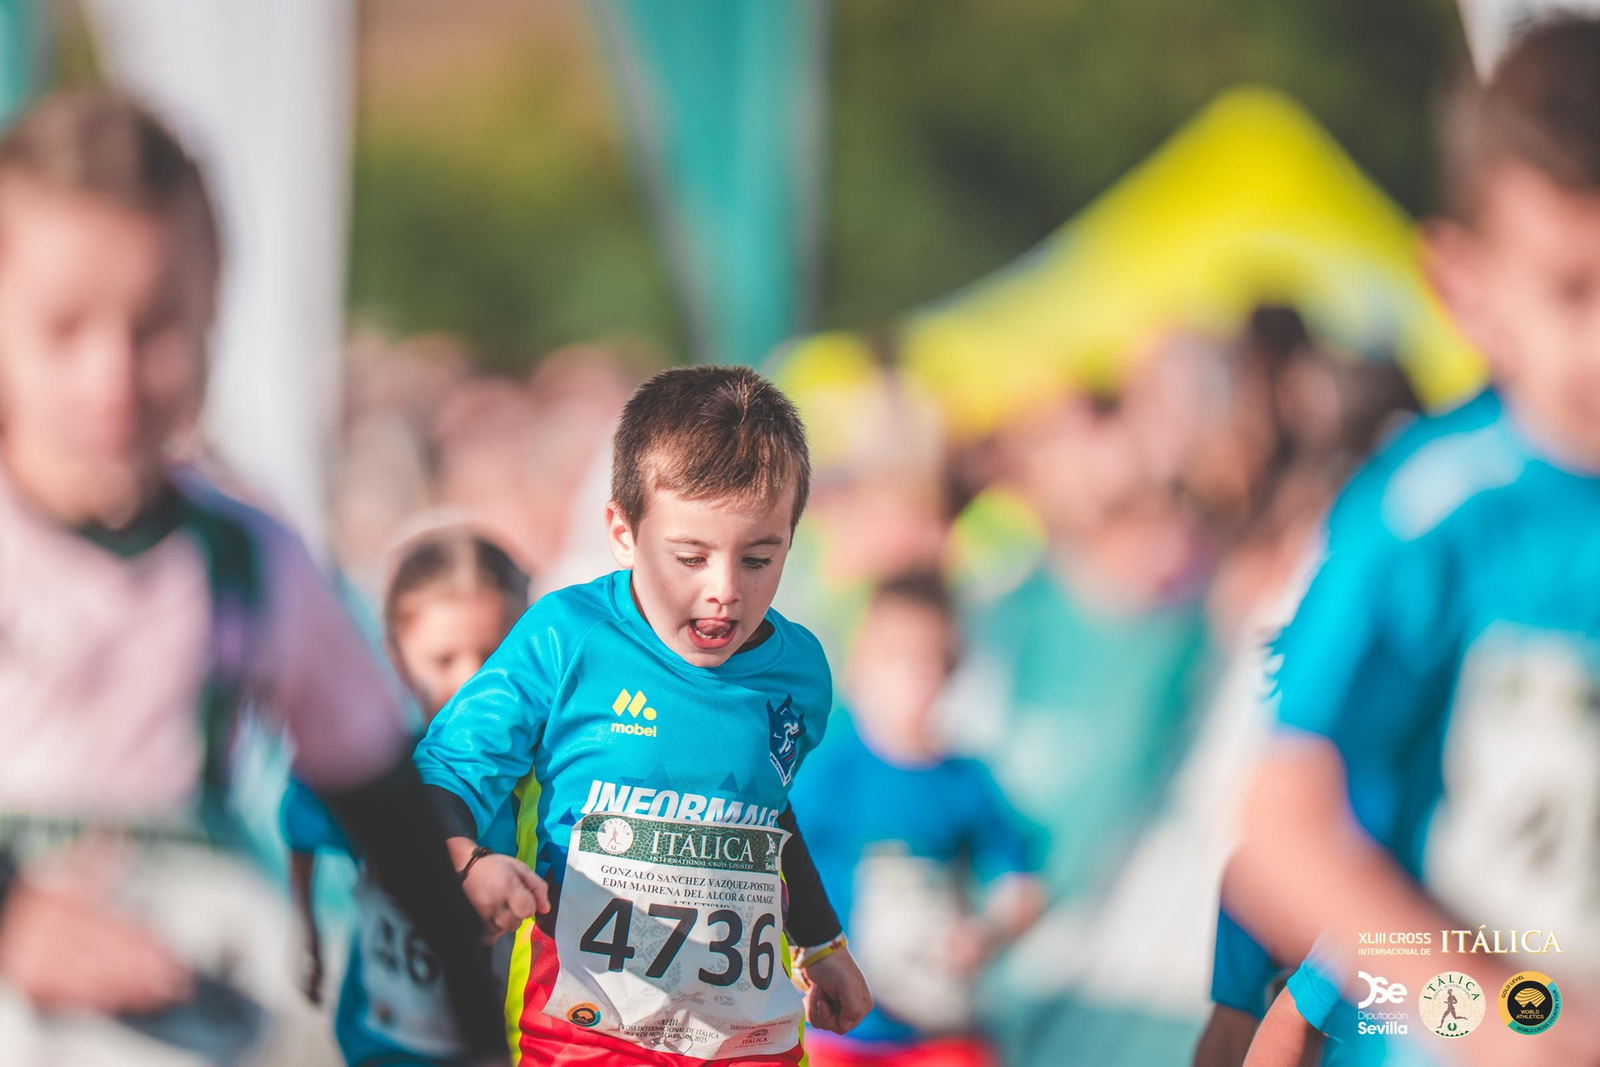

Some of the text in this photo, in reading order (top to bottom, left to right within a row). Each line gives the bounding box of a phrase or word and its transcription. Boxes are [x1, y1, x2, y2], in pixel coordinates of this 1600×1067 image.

[610, 722, 658, 738] mobel
[650, 827, 755, 863] ITÁLICA
[600, 864, 776, 893] GONZALO SANCHEZ VAZQUEZ-POSTIGO
[602, 877, 627, 890] EDM
[629, 881, 681, 898] MAIRENA
[683, 888, 704, 899] DEL
[705, 891, 737, 902] ALCOR
[738, 893, 746, 903] &
[578, 897, 776, 991] 4736
